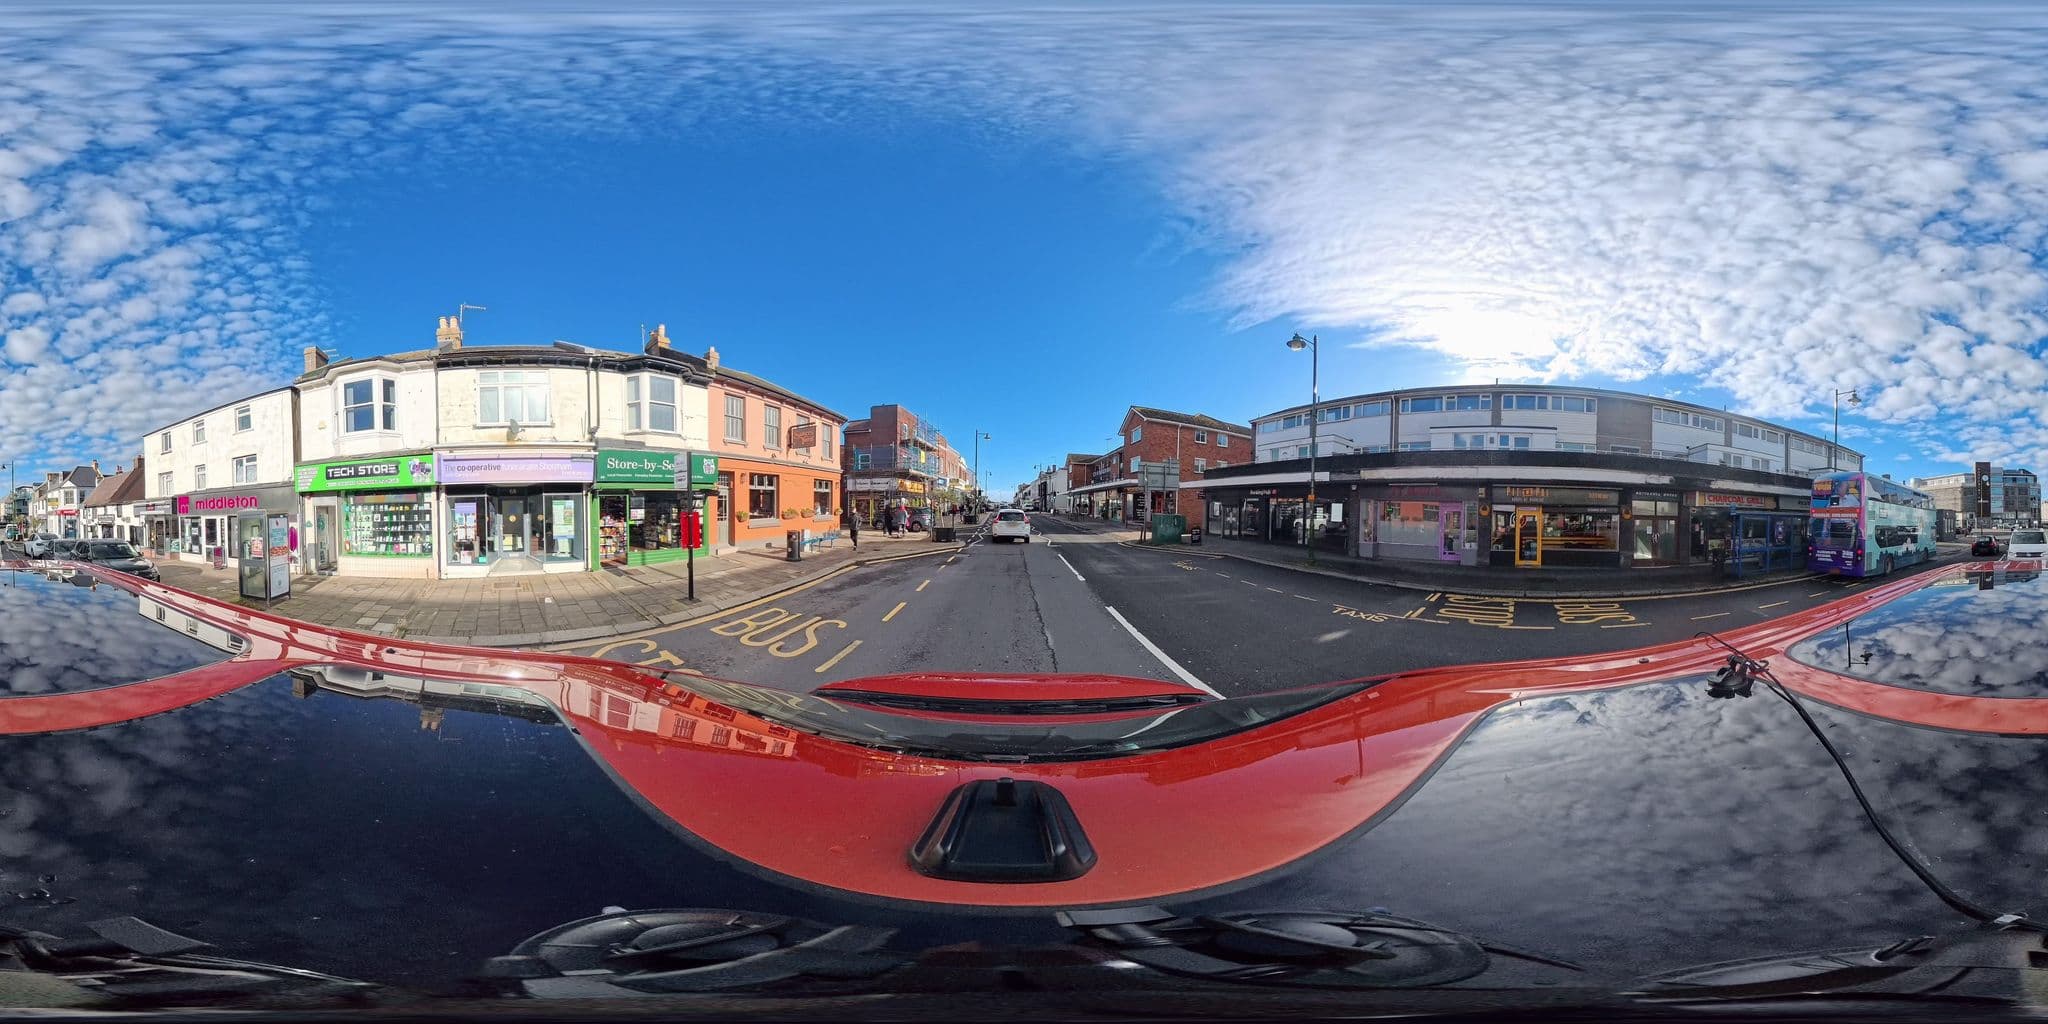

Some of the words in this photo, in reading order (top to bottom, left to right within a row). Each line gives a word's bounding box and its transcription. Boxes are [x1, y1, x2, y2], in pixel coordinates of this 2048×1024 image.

[328, 466, 355, 478] TECH
[358, 463, 398, 475] STORE
[456, 464, 502, 473] co-operative
[195, 496, 258, 510] middleton
[1707, 495, 1746, 504] CHARCOAL
[1331, 606, 1389, 623] TAXIS
[710, 608, 848, 657] BUS
